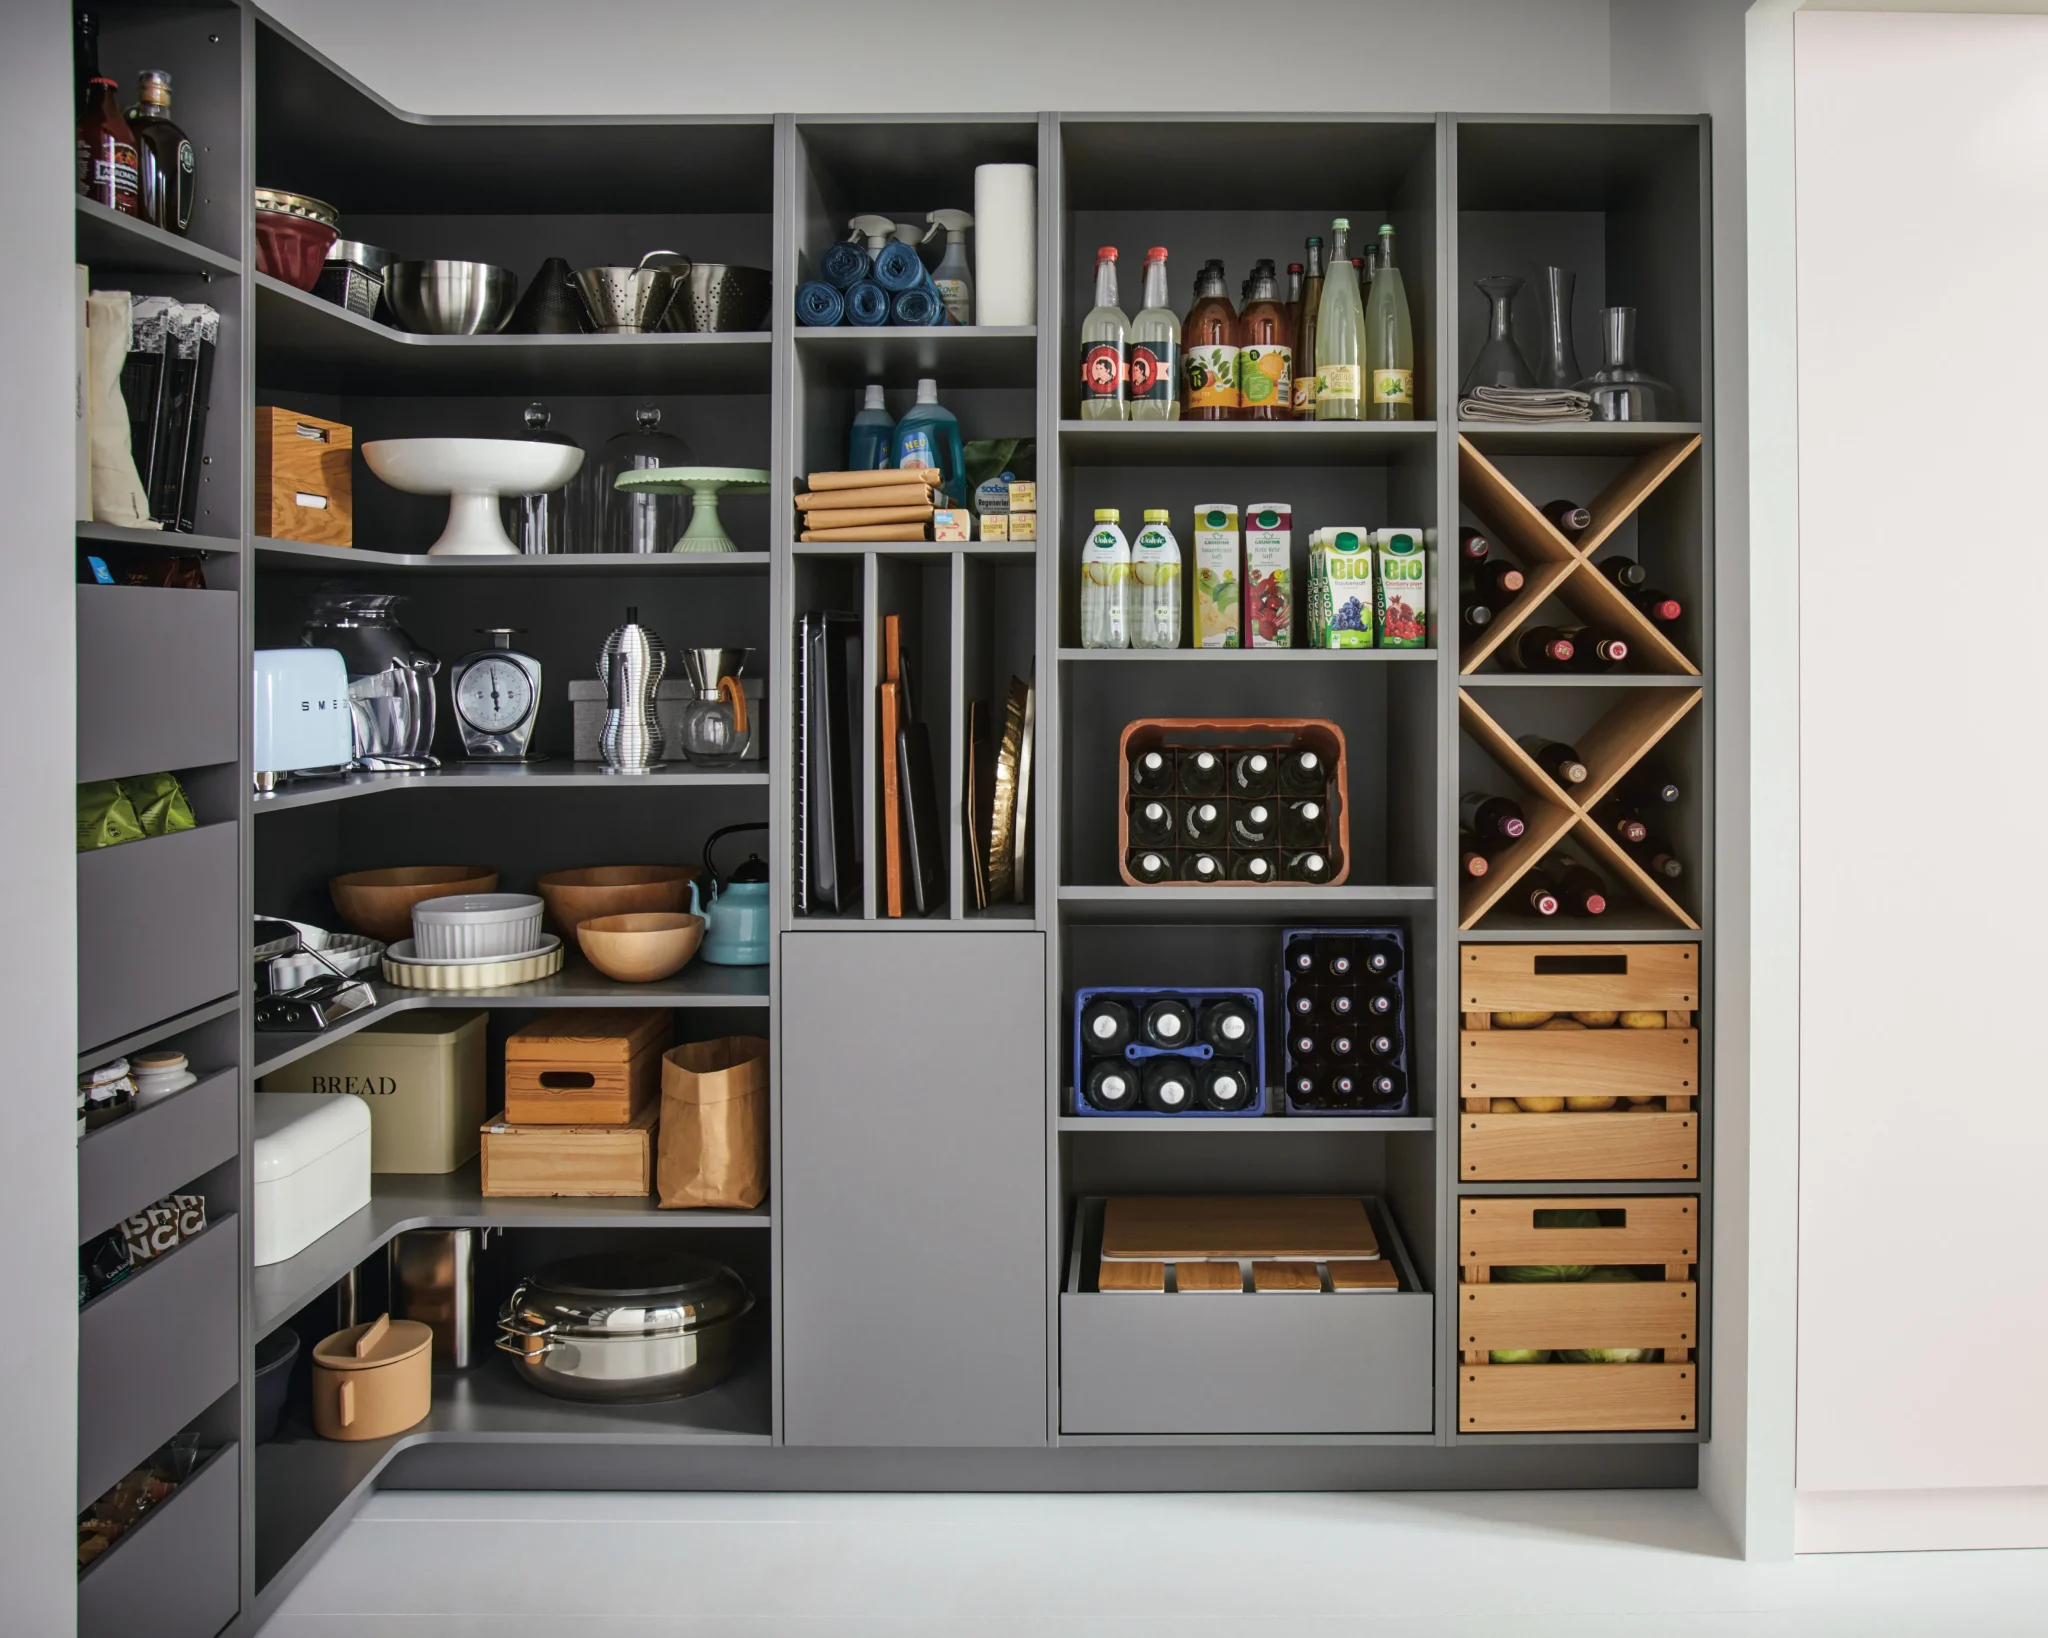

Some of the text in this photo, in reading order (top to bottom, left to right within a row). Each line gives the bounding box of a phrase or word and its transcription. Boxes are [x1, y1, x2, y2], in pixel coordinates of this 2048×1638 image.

[904, 439, 926, 451] NEU
[981, 484, 1009, 493] sodas
[978, 499, 1009, 507] Regenerier
[312, 1076, 397, 1095] BREAD
